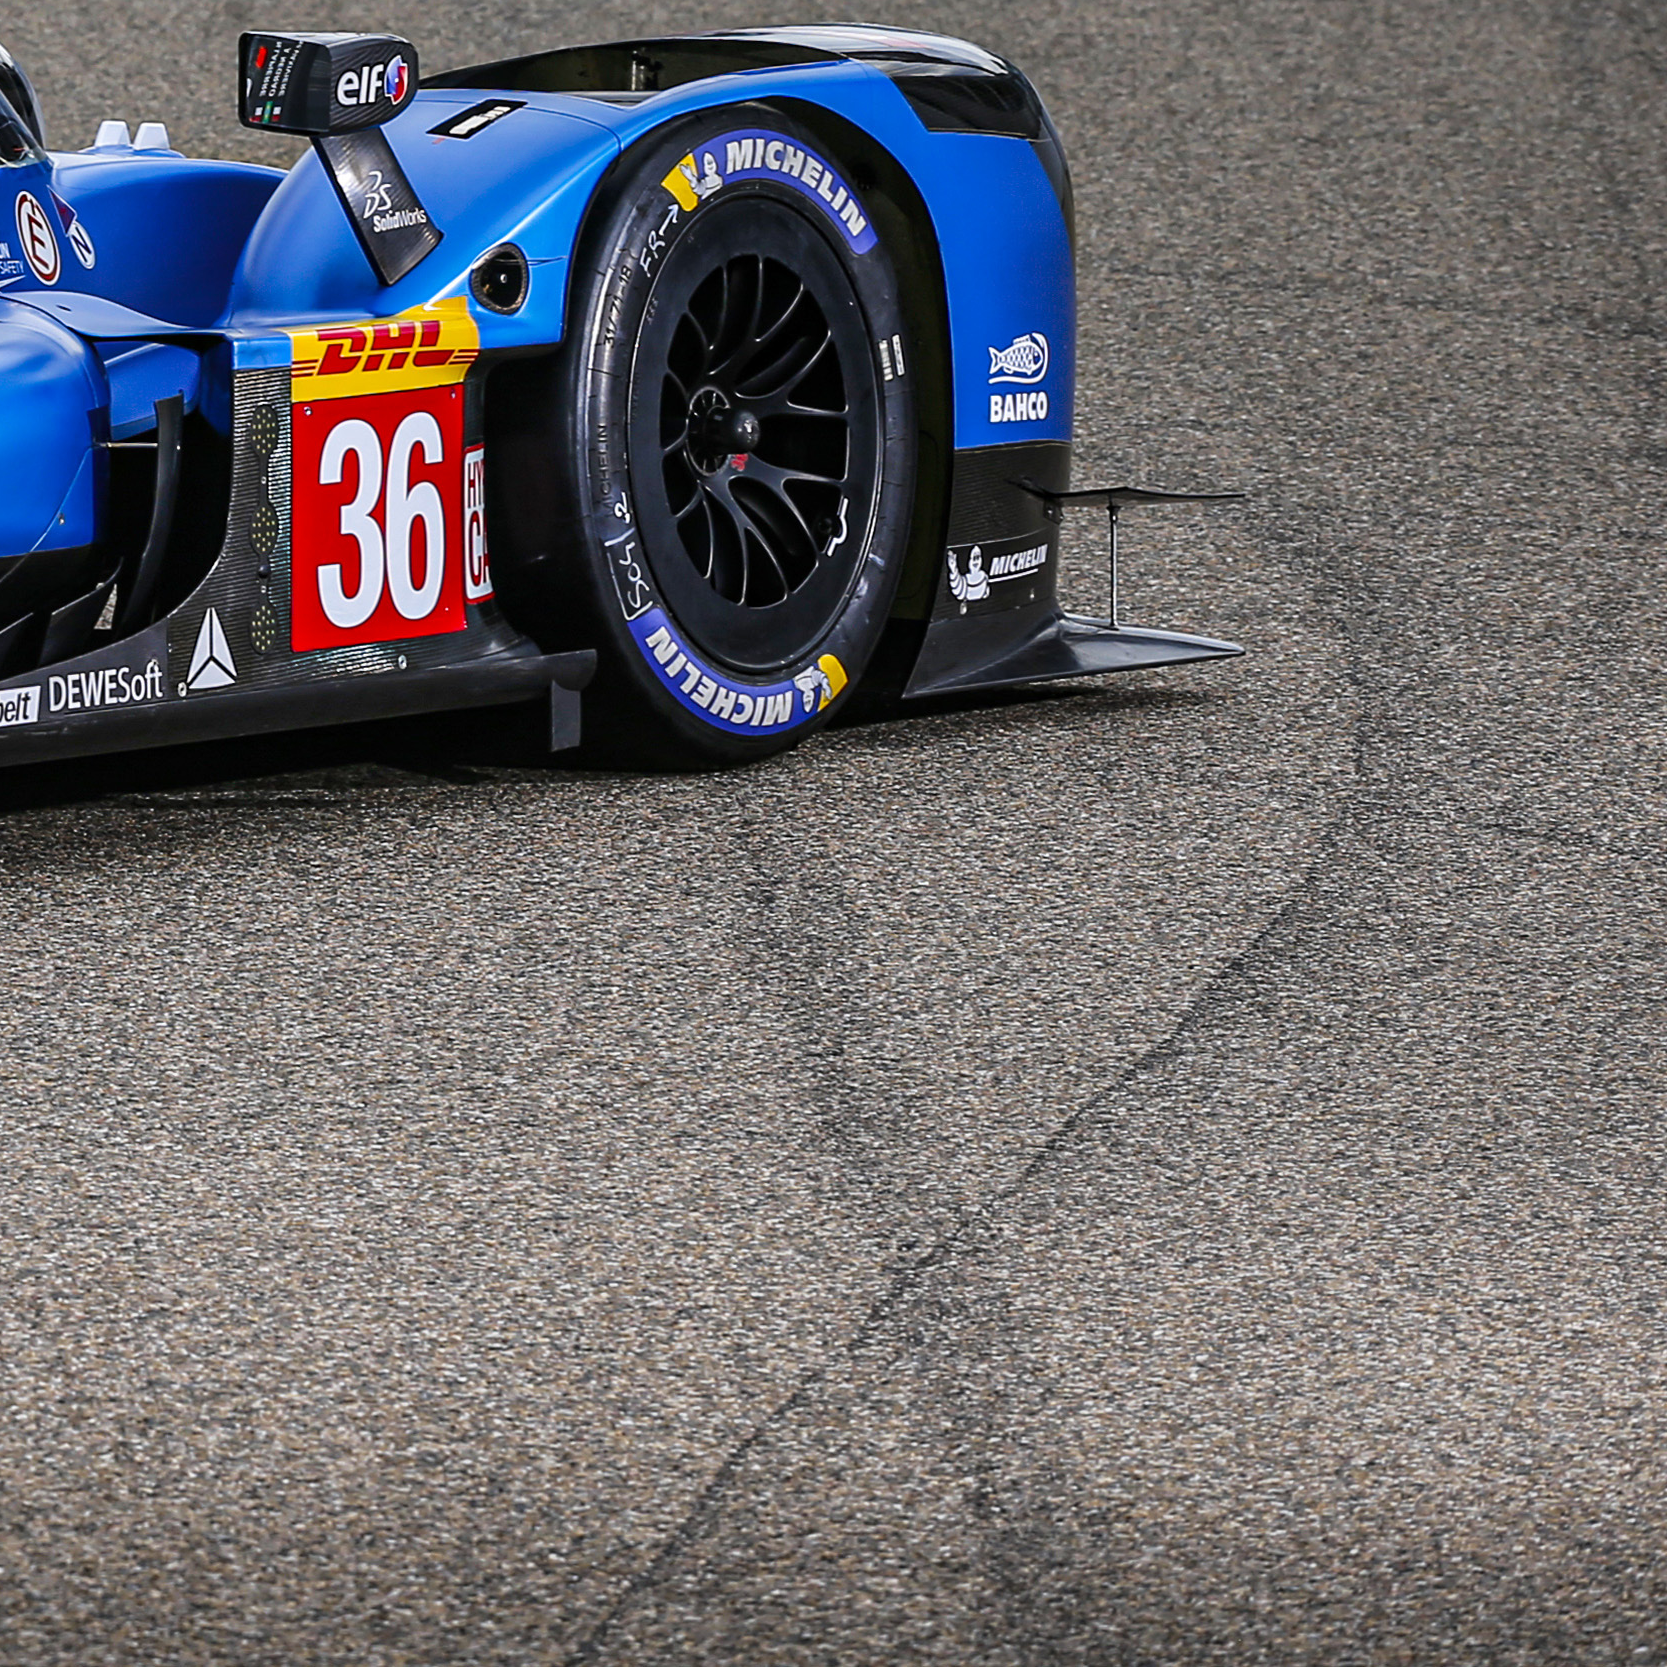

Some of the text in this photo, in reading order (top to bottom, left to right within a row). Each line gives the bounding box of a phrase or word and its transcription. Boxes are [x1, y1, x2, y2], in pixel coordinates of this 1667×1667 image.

[336, 64, 384, 106] elf
[725, 138, 867, 237] MICHELIN
[373, 207, 427, 233] SolidWorks
[317, 320, 456, 376] DHL
[989, 391, 1048, 423] BAHCO
[317, 411, 446, 628] 36
[989, 543, 1048, 576] MICHELIN
[48, 659, 163, 712] DEWESoft
[645, 625, 793, 727] MICHELIN
